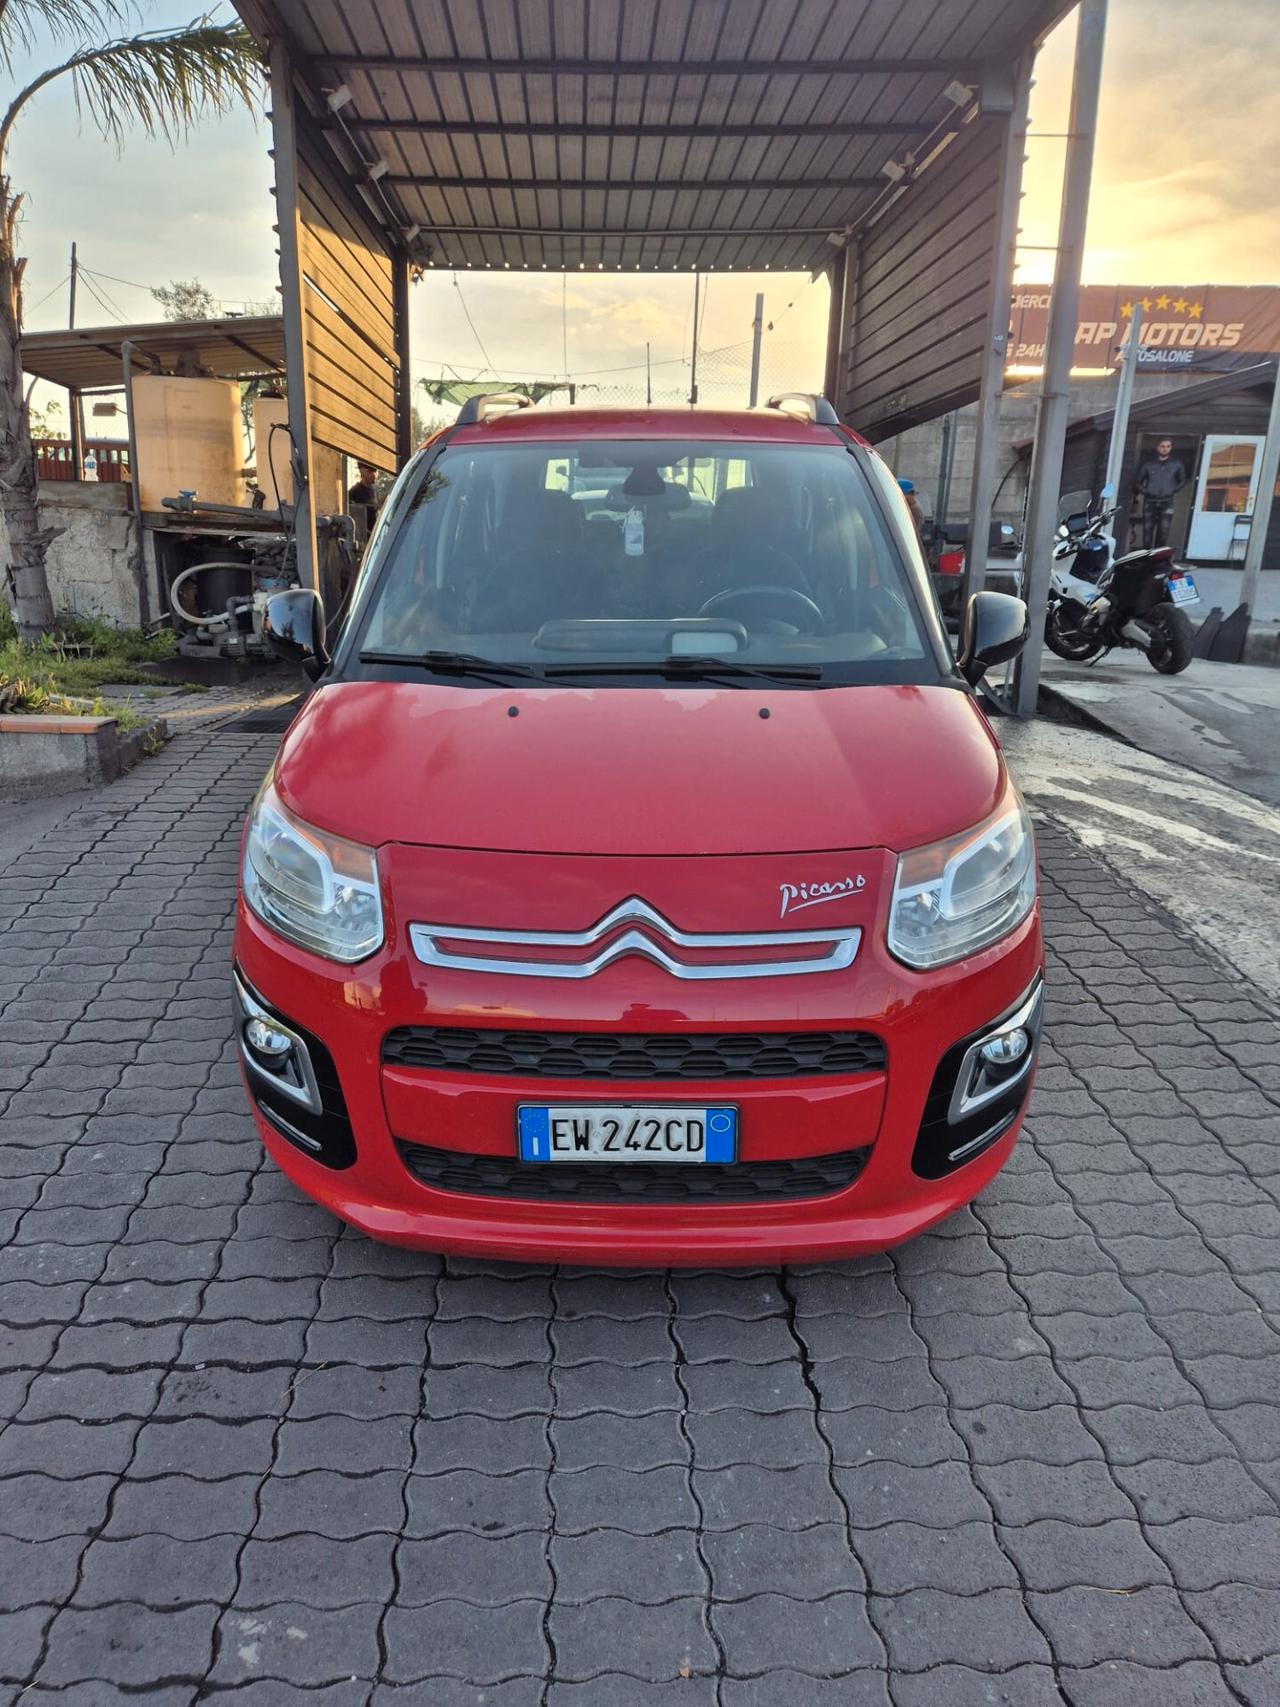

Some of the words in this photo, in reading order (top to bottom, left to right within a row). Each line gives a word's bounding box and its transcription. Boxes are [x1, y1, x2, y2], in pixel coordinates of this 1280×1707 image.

[1074, 322, 1117, 345] AP
[1120, 322, 1244, 346] MOTORS
[1015, 344, 1046, 357] 24H
